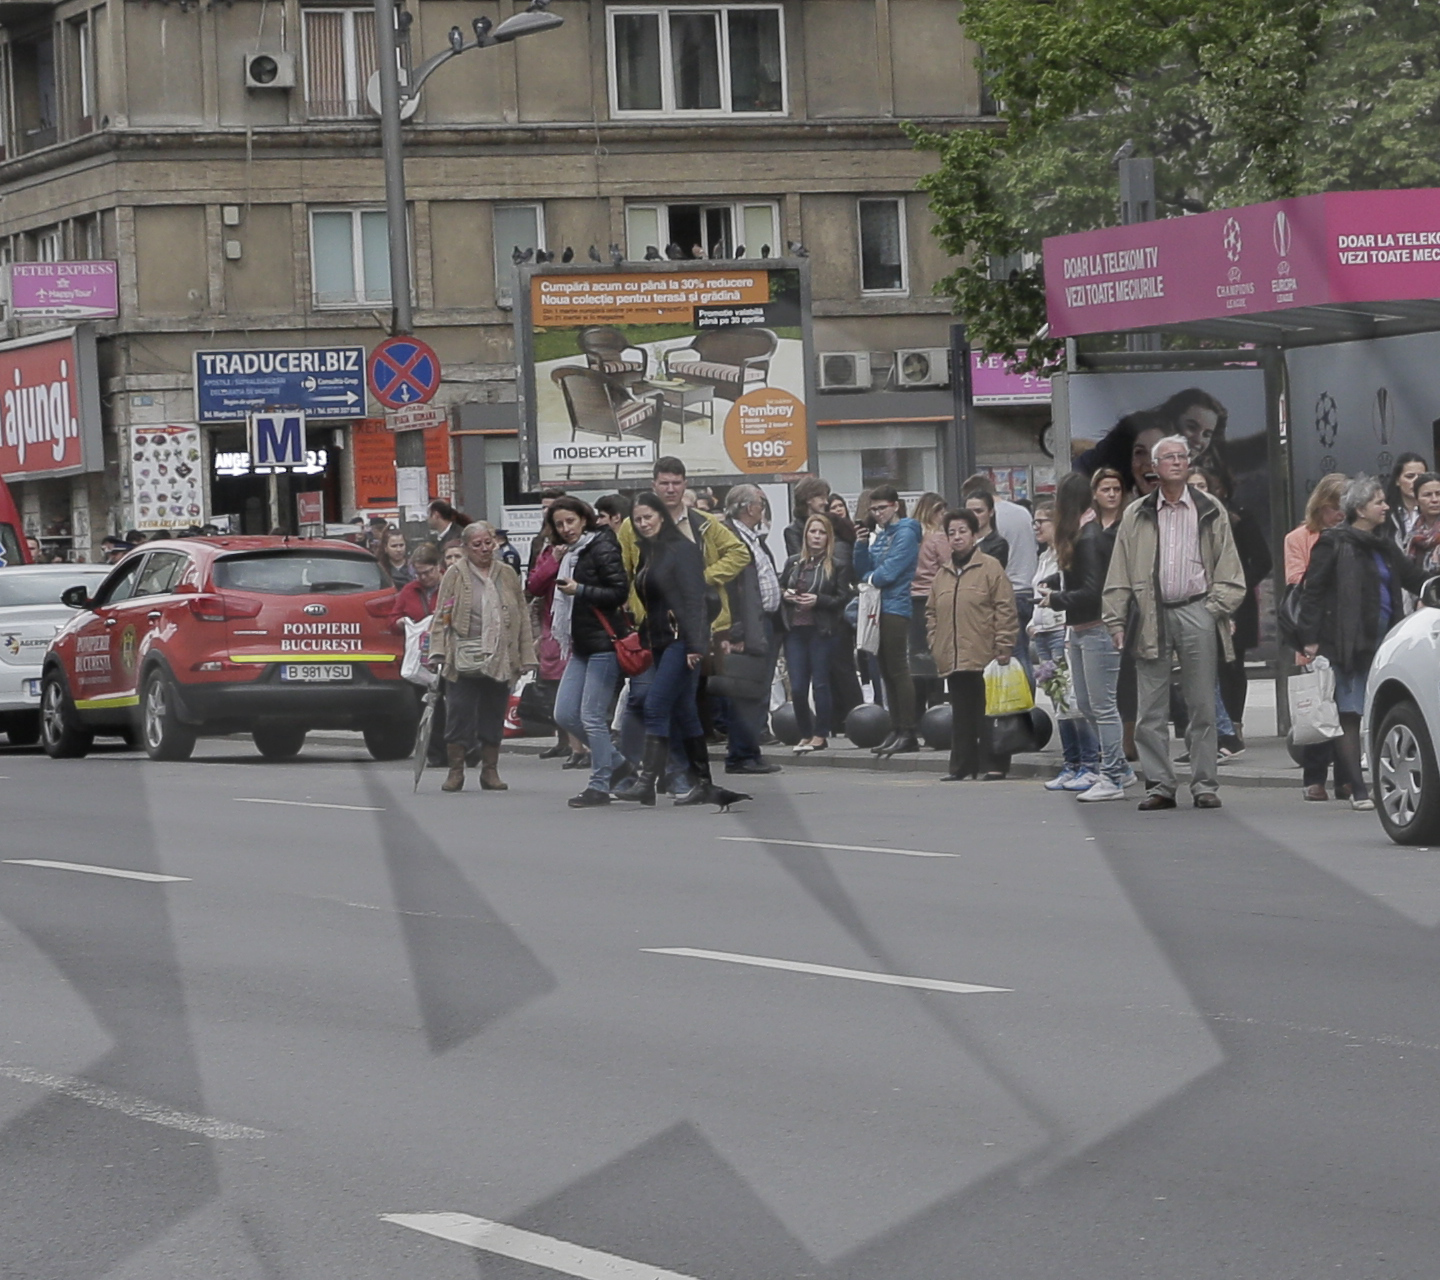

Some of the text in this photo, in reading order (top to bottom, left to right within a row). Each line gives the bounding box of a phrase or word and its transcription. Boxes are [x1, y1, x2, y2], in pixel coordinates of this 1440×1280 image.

[1338, 234, 1375, 249] DOAR
[1377, 233, 1395, 247] LA
[1064, 246, 1158, 279] DOAR LA TELEKOM TV
[1339, 250, 1369, 264] VEZI
[1370, 249, 1411, 263] TOATE
[13, 264, 114, 276] PETER EXPRESS
[540, 277, 754, 293] Cumpără acum cu până la 30% reducere
[1065, 276, 1165, 307] VEZI TOATE MECIURILE
[1216, 282, 1255, 298] CHAMPIONS
[541, 294, 570, 305] Noua
[616, 294, 651, 307] pentru
[653, 292, 686, 302] terasă
[201, 351, 359, 375] TRADUCERI.BIZ
[5, 360, 78, 465] ajungi.
[739, 405, 794, 417] Pembrey
[257, 418, 302, 463] M
[553, 445, 646, 460] MOBEXPERT
[744, 440, 784, 458] 1996
[283, 622, 361, 636] POMPIERII
[280, 638, 363, 653] BUCUREȘTI
[288, 665, 351, 678] B 981 YSU
